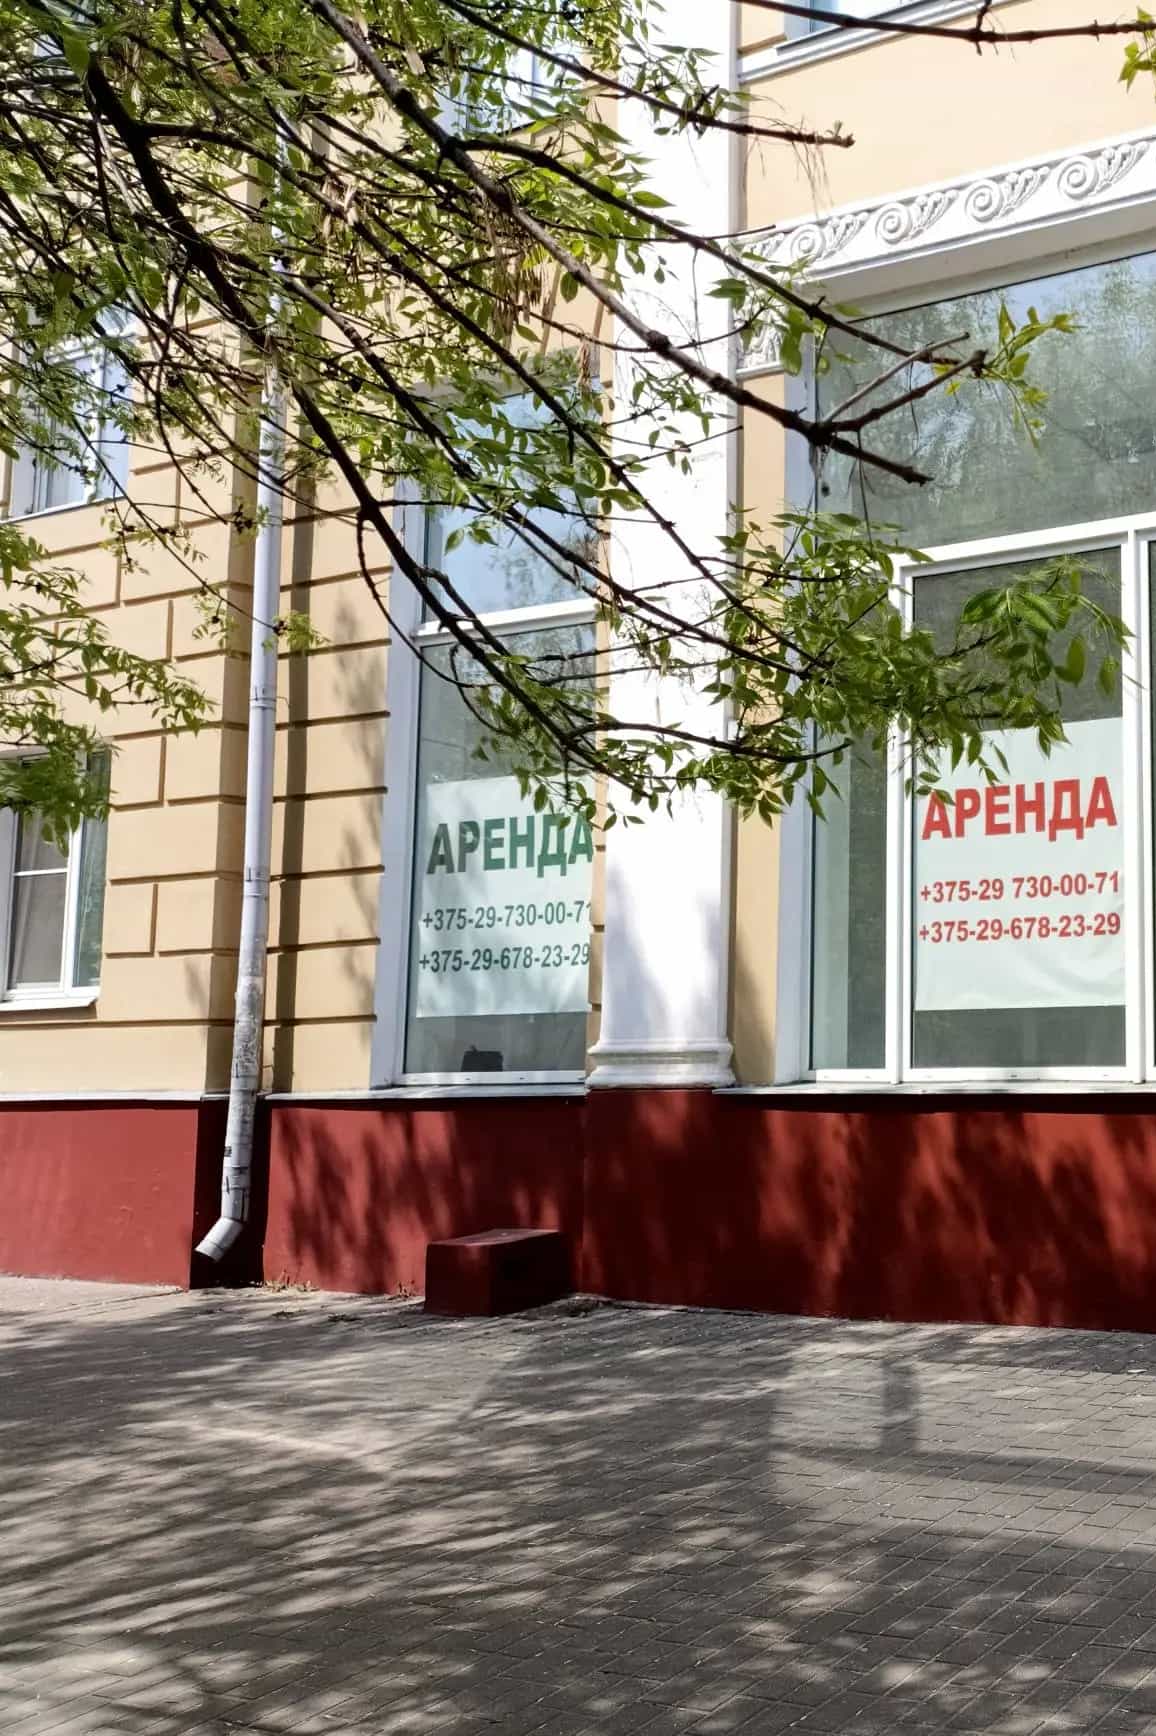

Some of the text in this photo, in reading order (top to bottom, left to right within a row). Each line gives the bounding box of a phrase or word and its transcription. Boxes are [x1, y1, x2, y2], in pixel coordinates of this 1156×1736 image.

[921, 776, 1117, 842] АРЕНДА
[427, 813, 593, 878] АРЕНДА
[920, 870, 1120, 902] +375-29 730-00-71
[919, 912, 1121, 943] +375-29-678-23-29
[419, 943, 590, 973] +375-29-678-23-29
